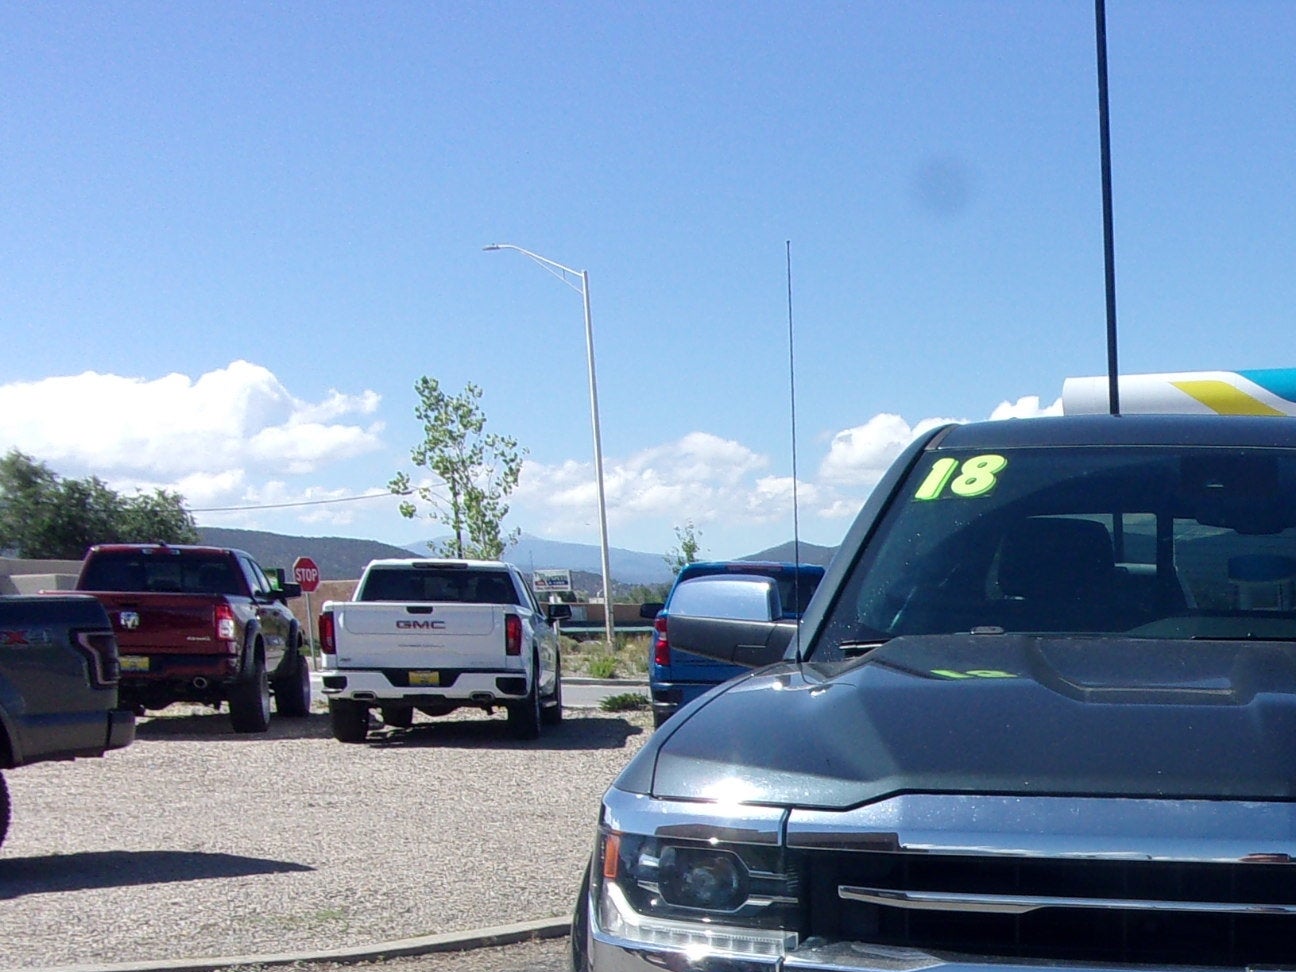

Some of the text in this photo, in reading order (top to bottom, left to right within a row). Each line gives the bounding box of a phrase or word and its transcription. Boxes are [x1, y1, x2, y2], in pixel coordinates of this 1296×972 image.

[914, 454, 1008, 500] 18
[295, 568, 318, 582] STOP
[395, 620, 446, 630] GMC
